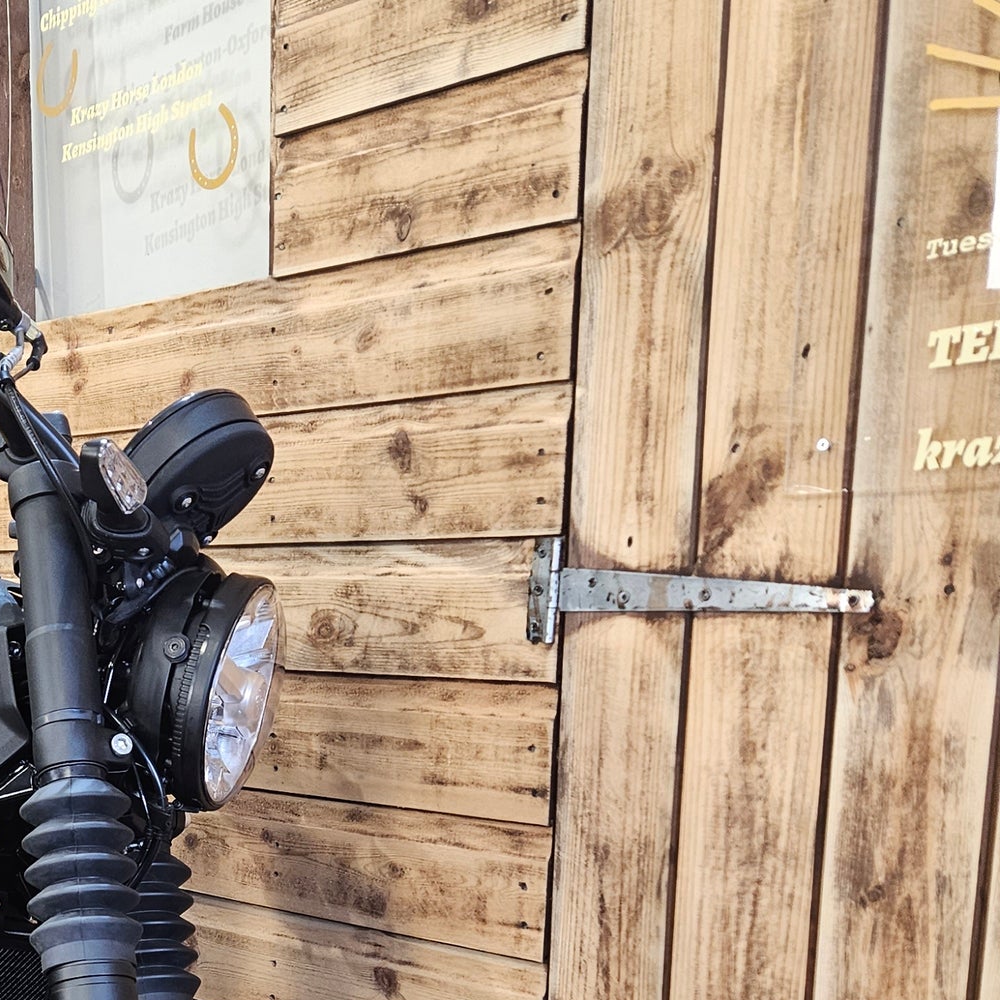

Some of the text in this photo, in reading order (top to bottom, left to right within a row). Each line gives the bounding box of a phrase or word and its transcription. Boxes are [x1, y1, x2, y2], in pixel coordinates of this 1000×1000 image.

[61, 89, 213, 163] Kensington High Street
[70, 61, 203, 127] Krazy Horse London
